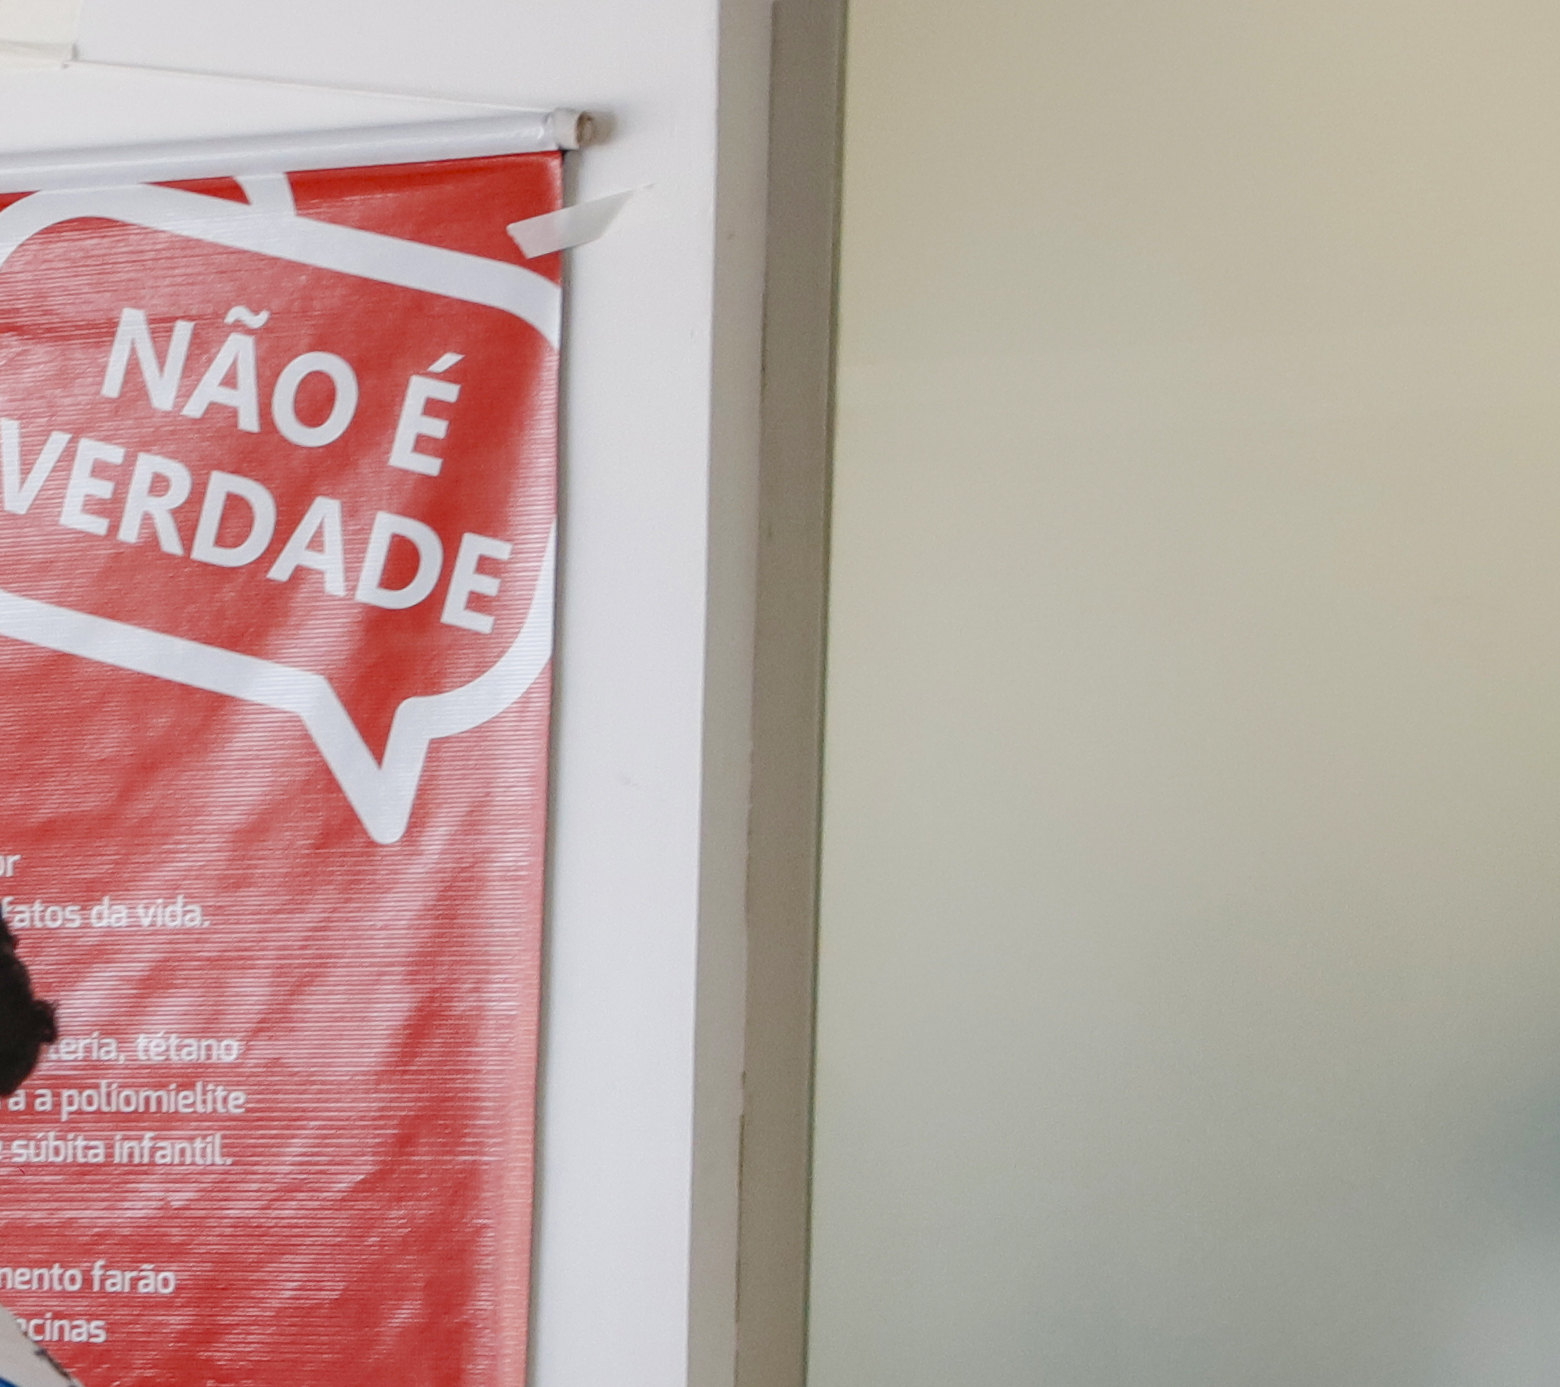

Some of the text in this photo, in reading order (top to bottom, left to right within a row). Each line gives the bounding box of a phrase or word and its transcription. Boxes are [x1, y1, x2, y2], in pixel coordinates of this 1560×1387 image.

[99, 304, 465, 477] NÃO É
[90, 895, 125, 928] da
[134, 894, 212, 928] vida.
[135, 1030, 240, 1063] tétano
[34, 1088, 54, 1112] a
[60, 1080, 248, 1122] poliomielite
[11, 1131, 106, 1163] súbita
[114, 1132, 235, 1166] infantil.
[91, 1260, 176, 1294] farão
